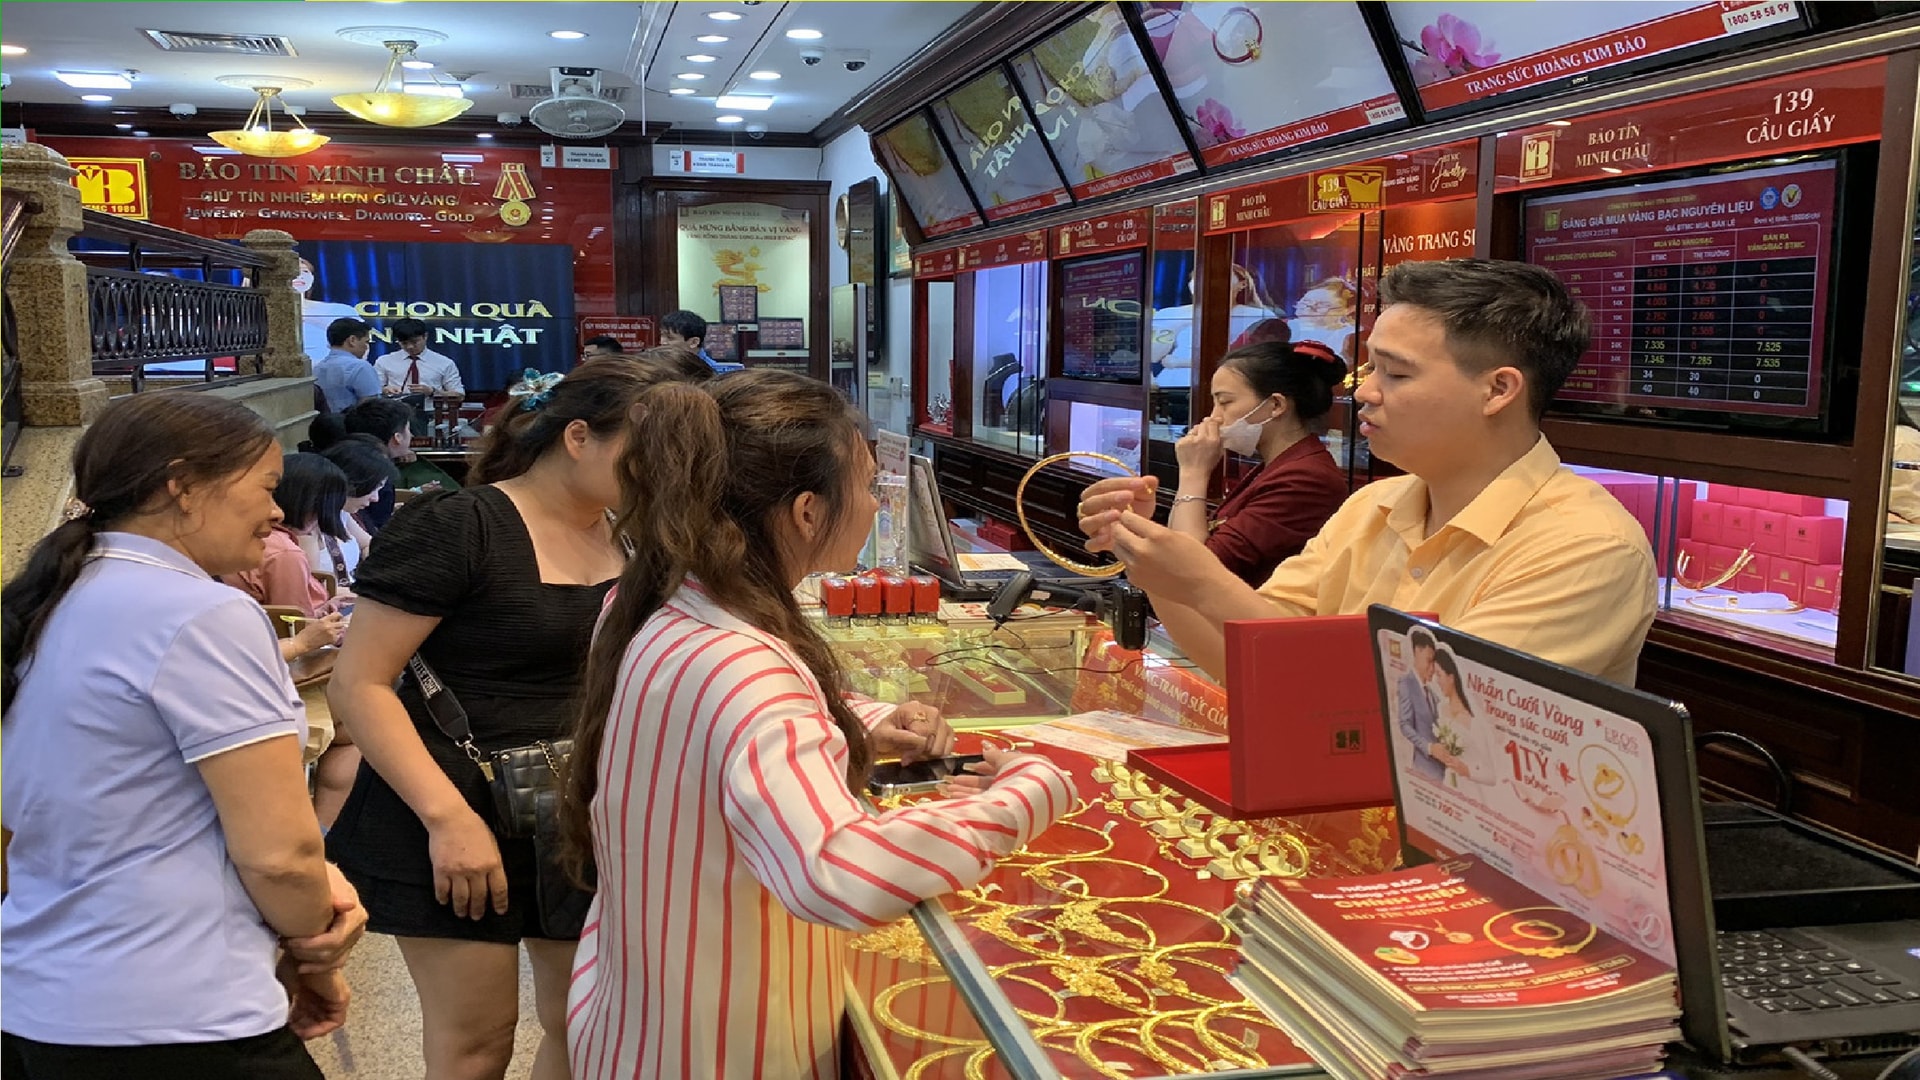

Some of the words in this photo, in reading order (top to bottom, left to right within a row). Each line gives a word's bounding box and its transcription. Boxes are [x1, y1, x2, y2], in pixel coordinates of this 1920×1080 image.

[1727, 13, 1749, 26] 1800
[1750, 10, 1763, 20] 58
[1764, 6, 1776, 17] 58
[1777, 3, 1789, 13] 99
[1465, 74, 1506, 94] TRANG
[1507, 67, 1533, 83] SỨC
[1534, 54, 1581, 77] HOÀNG
[1582, 47, 1612, 64] KIM
[1613, 35, 1647, 54] BẢO
[1773, 88, 1813, 116] 139
[1295, 127, 1310, 139] KIM
[1588, 128, 1615, 145] BẢO
[1617, 122, 1640, 140] TÍN
[1746, 117, 1782, 144] CẦU
[1788, 108, 1835, 137] GIẤY
[1576, 151, 1609, 167] MINH
[1612, 142, 1650, 161] CHÂU
[179, 158, 240, 180] BẢO
[248, 161, 298, 181] TÍN
[307, 164, 387, 183] MINH
[394, 162, 480, 185] CHÂU
[1324, 177, 1339, 192] 139
[201, 190, 233, 202] GIỮ
[238, 190, 264, 202] TÍN
[271, 191, 325, 204] NHIỆM
[329, 192, 368, 204] HƠN
[374, 193, 406, 205] GIỮ
[410, 193, 456, 206] VÀNG
[1589, 214, 1604, 226] GIÁ
[1606, 214, 1625, 224] MUA
[1629, 209, 1654, 222] VÀNG
[1658, 209, 1678, 221] BẠC
[1681, 201, 1725, 217] NGUYÊN
[1728, 200, 1753, 214] LIỆU
[1383, 234, 1414, 253] VÀNG
[1418, 231, 1459, 250] TRANG
[471, 300, 553, 321] QUÀ
[1758, 311, 1766, 321] 0
[435, 324, 544, 348] NHẬT
[1757, 326, 1765, 336] 0
[1756, 341, 1782, 352] 7.525
[1689, 356, 1713, 366] 7.285
[1755, 357, 1781, 368] 7.535
[1642, 369, 1653, 379] 34
[1689, 372, 1700, 382] 30
[1754, 373, 1762, 384] 0
[1641, 384, 1653, 393] 40
[1688, 386, 1699, 396] 40
[1753, 390, 1761, 400] 0
[1467, 672, 1504, 701] Nhẫn
[1507, 688, 1540, 716] Cưới
[1543, 701, 1585, 737] Vàng
[1484, 699, 1517, 728] Trang
[1519, 715, 1540, 734] sức
[1542, 727, 1569, 747] cưới
[1504, 739, 1522, 781] 1
[1334, 896, 1411, 908] CHÍNH
[1415, 886, 1467, 902] HIỆU
